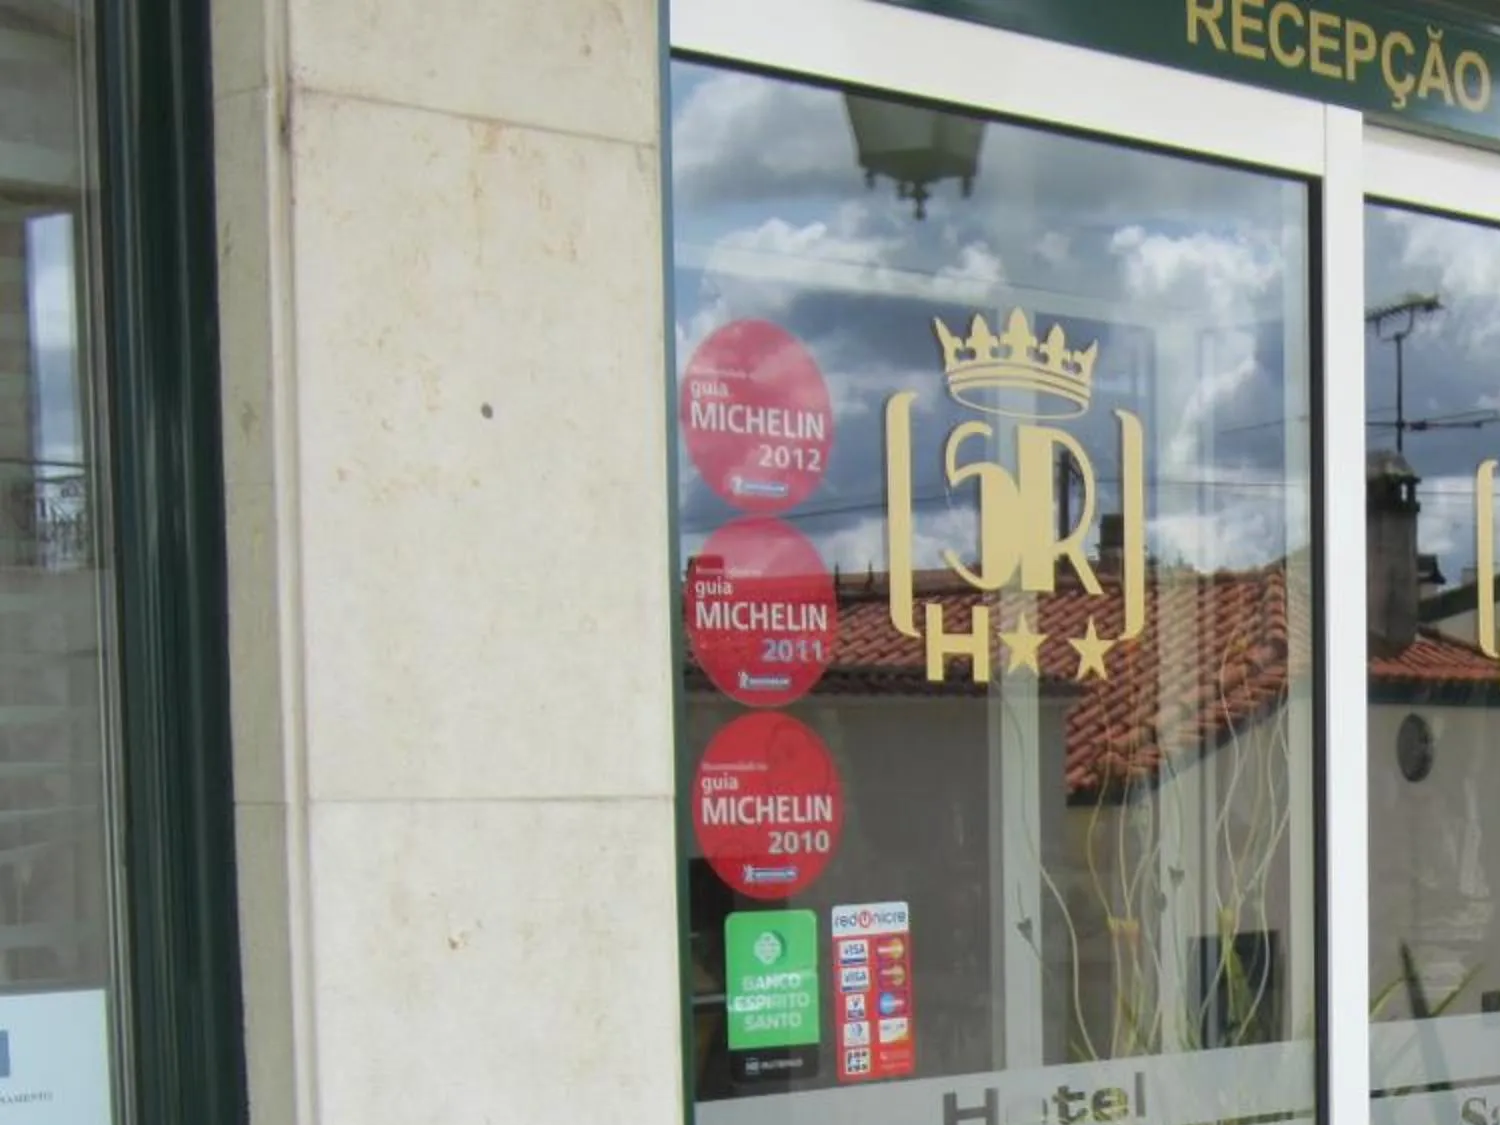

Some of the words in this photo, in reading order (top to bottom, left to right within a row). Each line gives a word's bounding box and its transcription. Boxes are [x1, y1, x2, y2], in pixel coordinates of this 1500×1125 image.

[690, 402, 825, 440] MICHELIN
[758, 444, 821, 472] 2012
[695, 576, 733, 599] guia
[695, 601, 828, 632] MICHELIN
[762, 638, 824, 663] 2011
[701, 772, 739, 795] guia
[701, 795, 834, 825] MICHELIN
[767, 829, 831, 855] 2010
[742, 972, 802, 991] BANCO
[744, 1012, 803, 1032] SANTO
